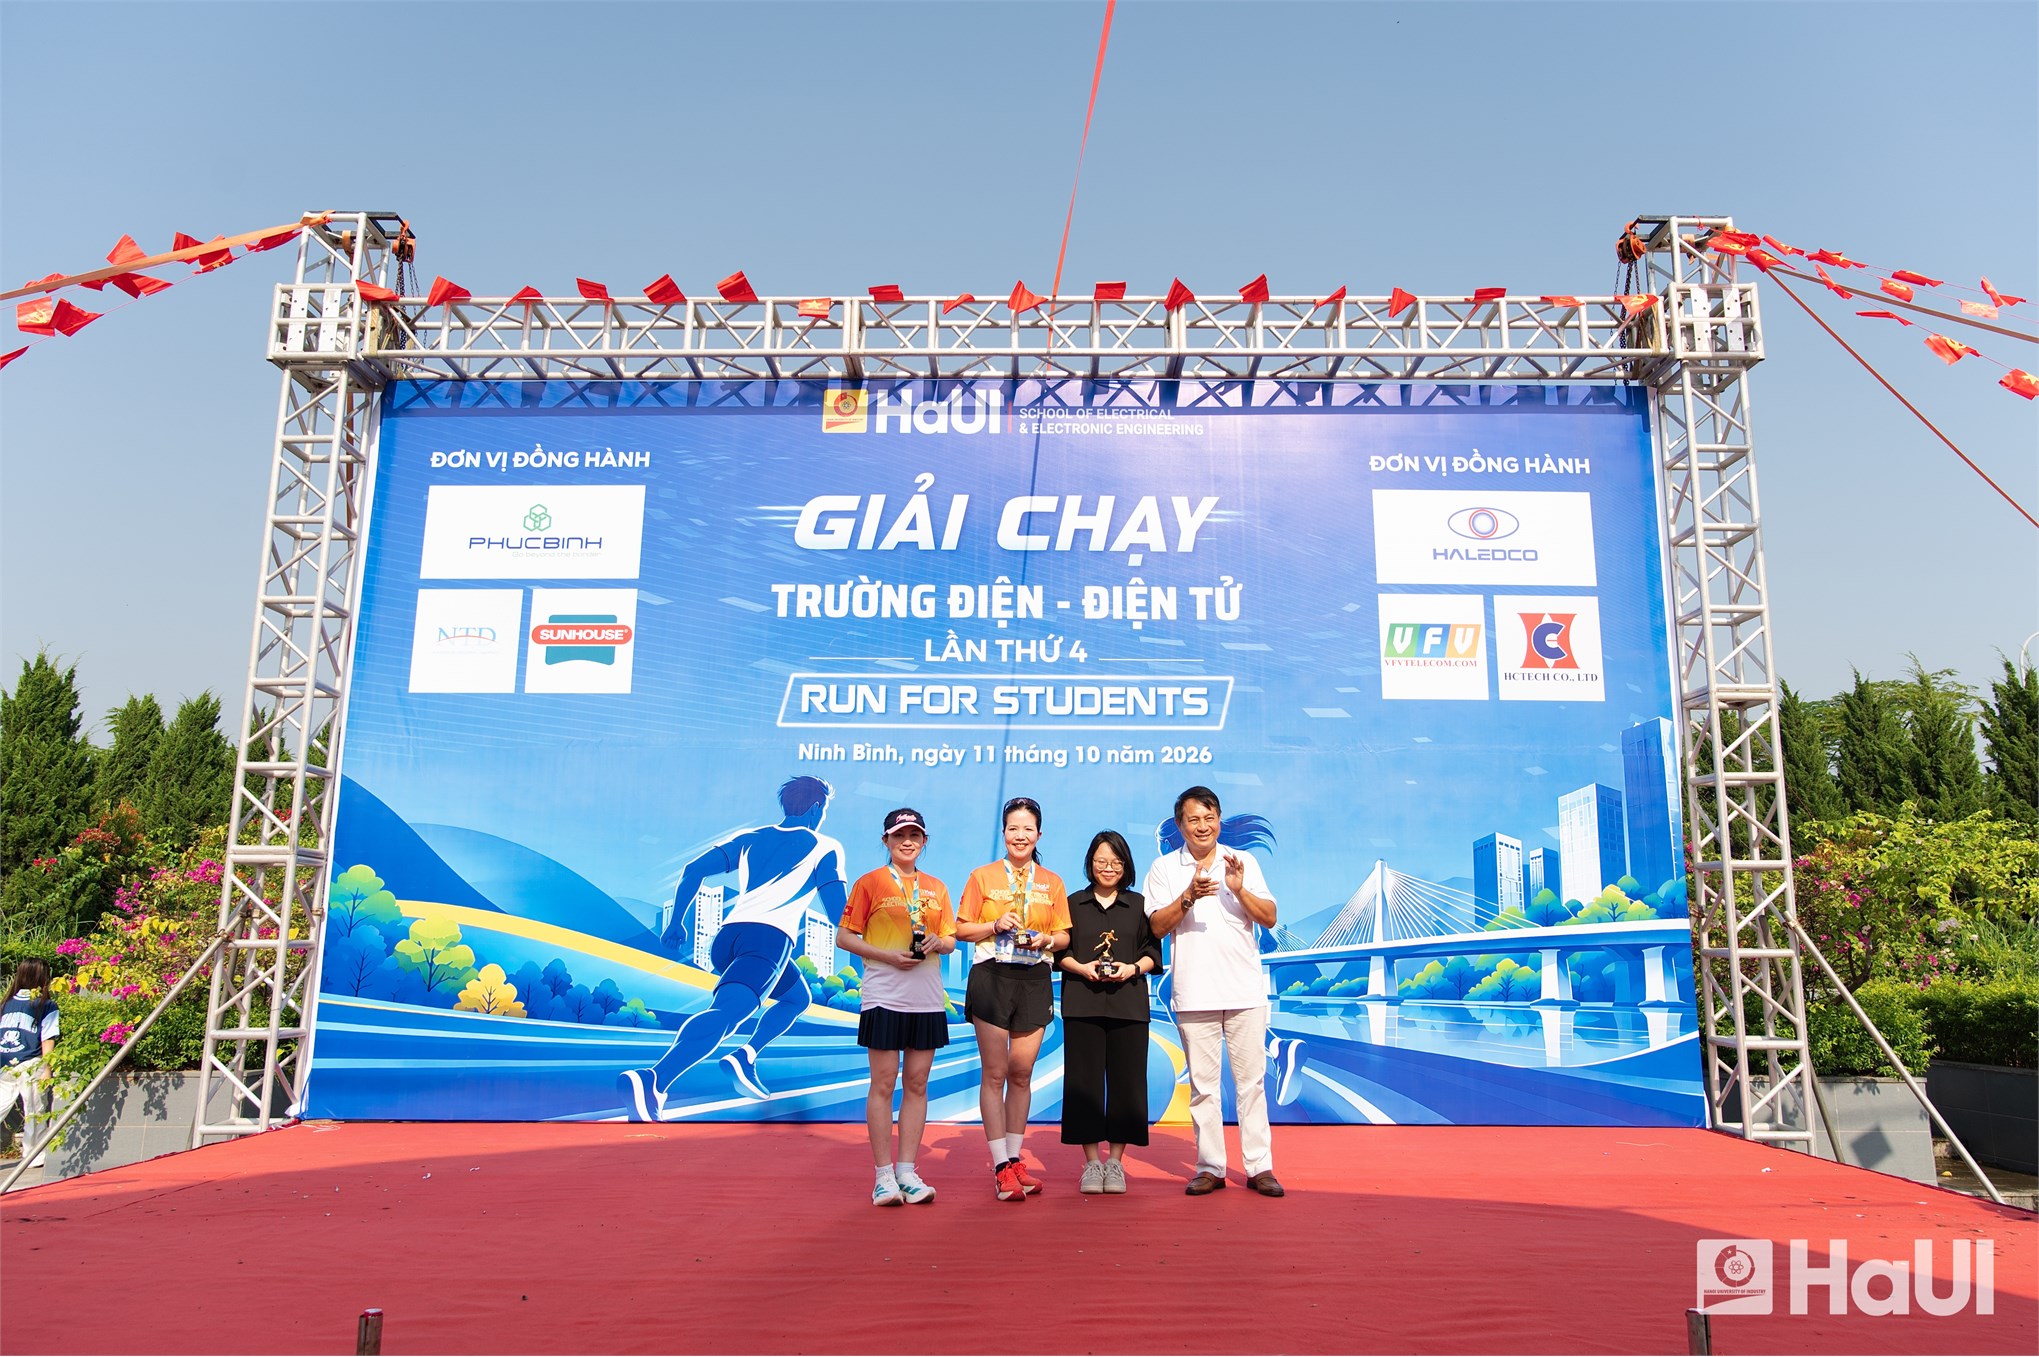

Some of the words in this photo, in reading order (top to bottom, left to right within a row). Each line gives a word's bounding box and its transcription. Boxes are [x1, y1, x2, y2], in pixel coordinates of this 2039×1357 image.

[875, 388, 1000, 435] HaUI
[1019, 408, 1073, 419] SCHOOL
[1075, 409, 1093, 419] OF
[1096, 409, 1175, 420] ELECTRICAL
[1019, 423, 1029, 434] &
[1031, 423, 1113, 435] ELECTRONIC
[1116, 423, 1204, 436] ENGINEERING
[430, 449, 481, 468] ĐƠN
[485, 451, 508, 472] VỊ
[512, 443, 579, 468] ĐỒNG
[584, 447, 651, 468] HÀNH
[1369, 453, 1420, 472] ĐƠN
[1424, 455, 1447, 477] VỊ
[1452, 448, 1519, 473] ĐỒNG
[1525, 453, 1591, 474] HÀNH
[794, 472, 969, 550] GIẢI
[997, 495, 1219, 567] CHẠY
[469, 537, 602, 549] PHUCBINH
[1433, 548, 1539, 562] HALEDCO
[771, 575, 936, 618] TRƯỜNG
[947, 575, 1044, 628] ĐIỆN
[1082, 577, 1177, 630] ĐIỆN
[1189, 575, 1244, 621] TỬ
[925, 629, 987, 662] LẦN
[995, 633, 1065, 663] THỨ
[1069, 640, 1088, 663] 4
[1384, 659, 1478, 668] VFVTELECOM.COM
[1504, 672, 1550, 681] HCTECH
[1553, 673, 1575, 682] CO.,
[1577, 673, 1598, 682] LTD
[801, 684, 887, 714] RUN
[899, 685, 979, 715] FOR
[993, 685, 1209, 717] STUDENTS
[798, 743, 846, 761] Ninh
[852, 742, 904, 765] Bình,
[911, 743, 966, 767] ngày
[973, 745, 995, 762] 11
[1004, 743, 1068, 768] tháng
[1075, 745, 1100, 763] 10
[1107, 745, 1155, 763] năm
[1160, 746, 1213, 764] 2026
